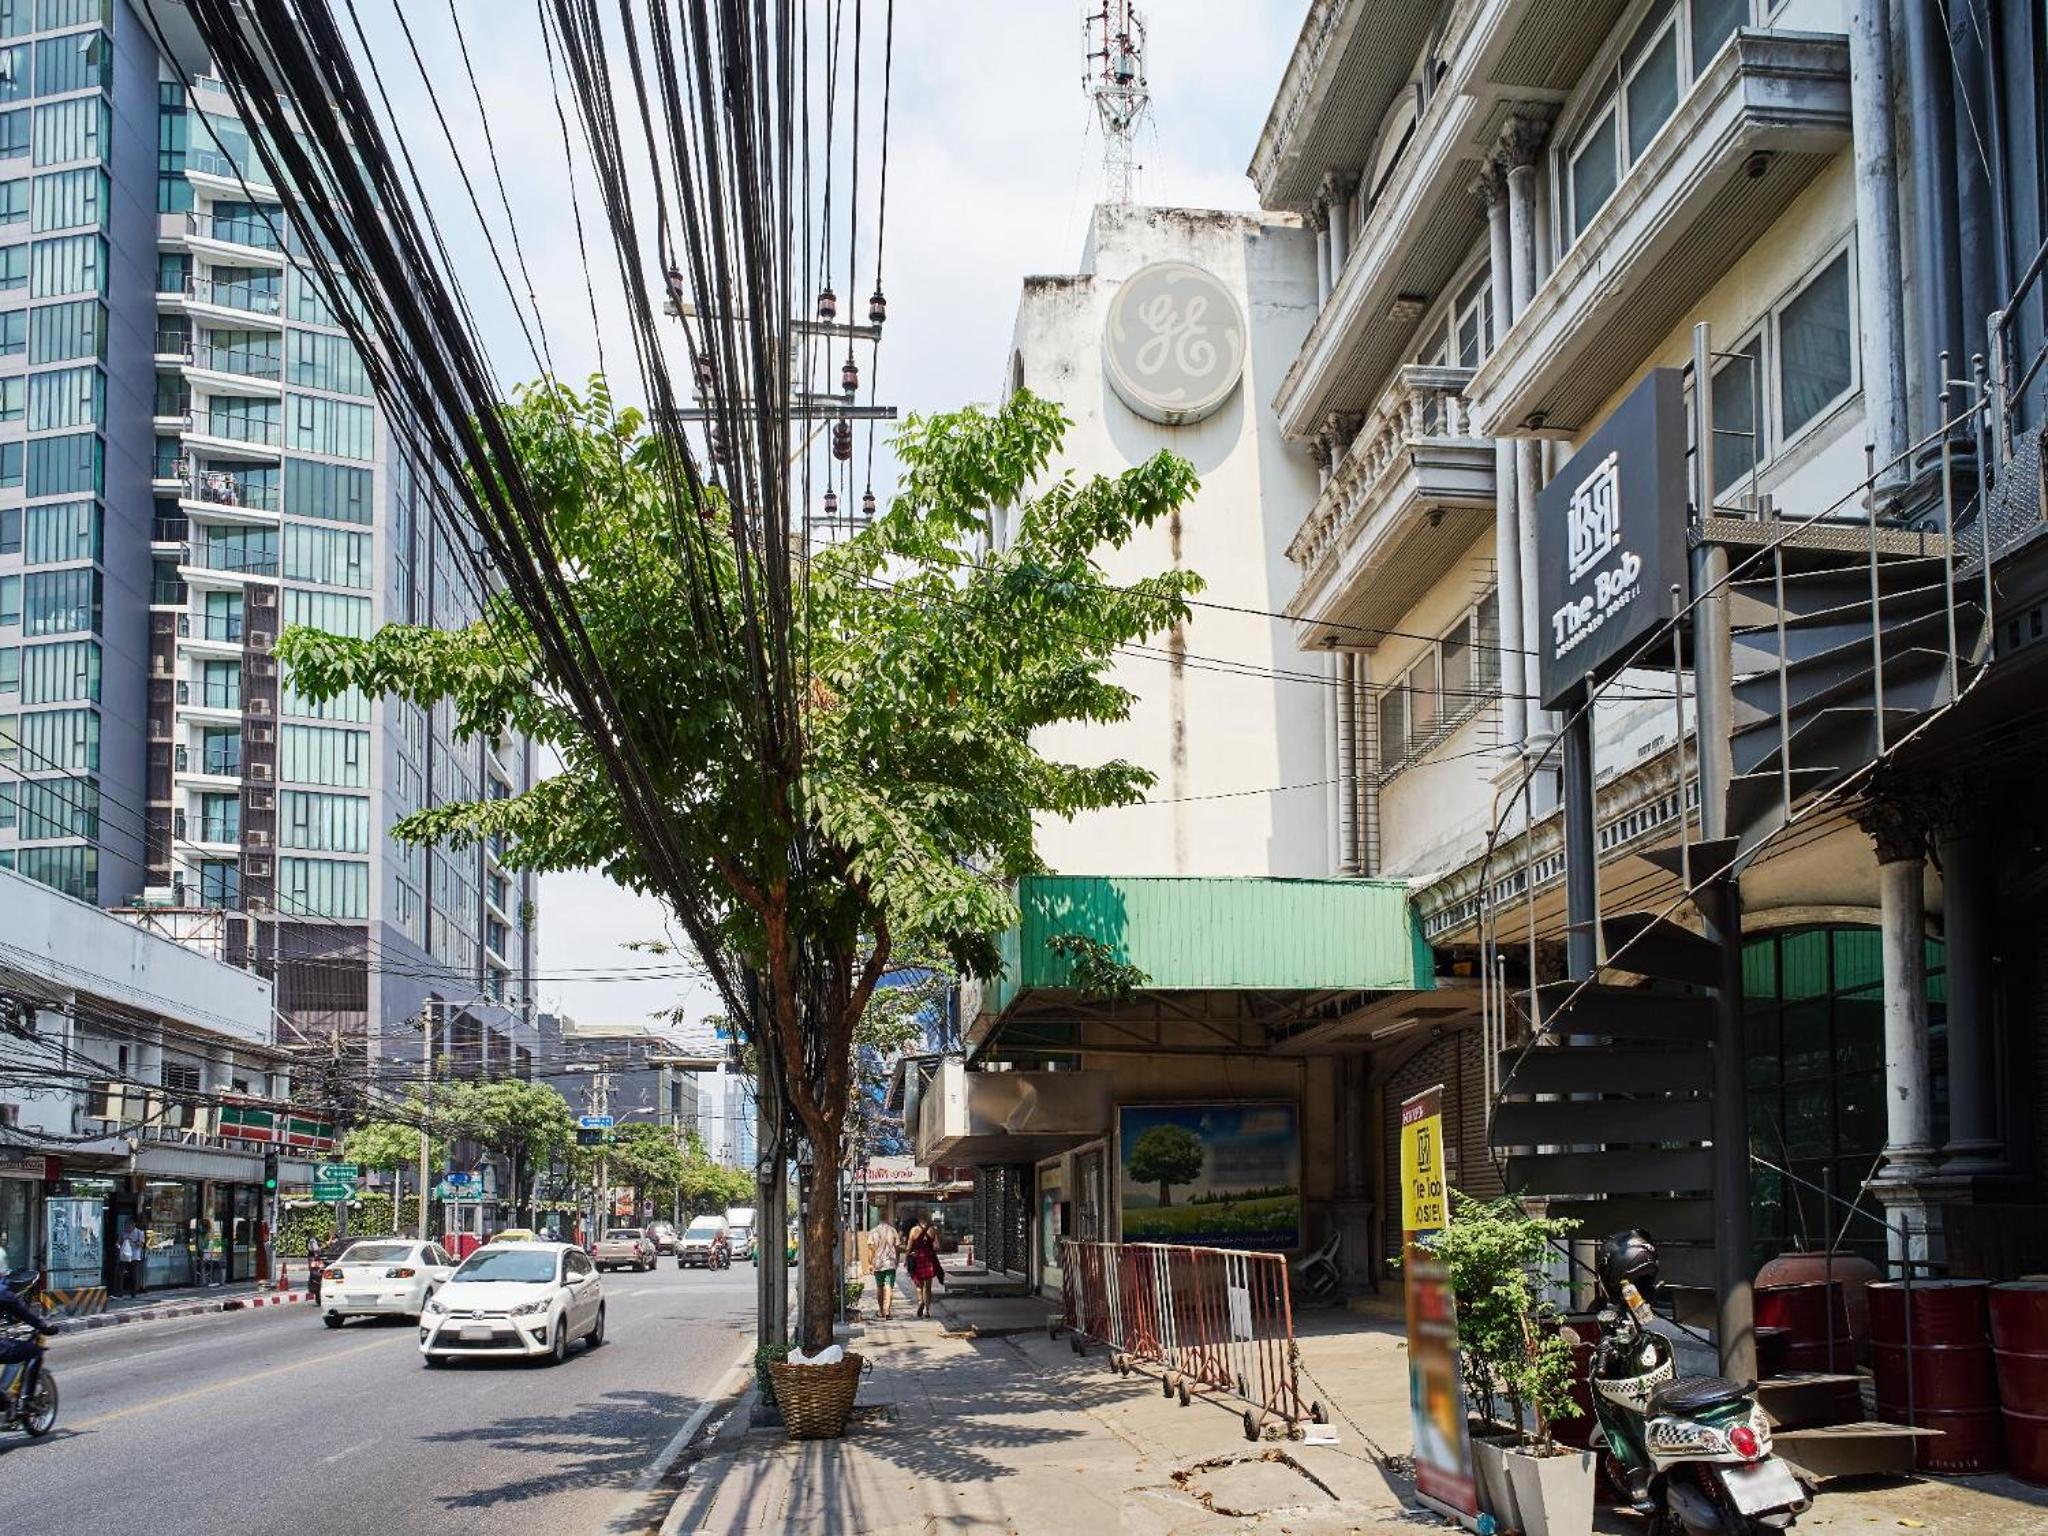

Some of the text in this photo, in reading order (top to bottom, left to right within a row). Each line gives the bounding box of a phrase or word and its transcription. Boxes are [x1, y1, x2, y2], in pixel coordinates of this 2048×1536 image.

[1552, 551, 1642, 645] The Bob
[1606, 583, 1641, 618] HOSTEL
